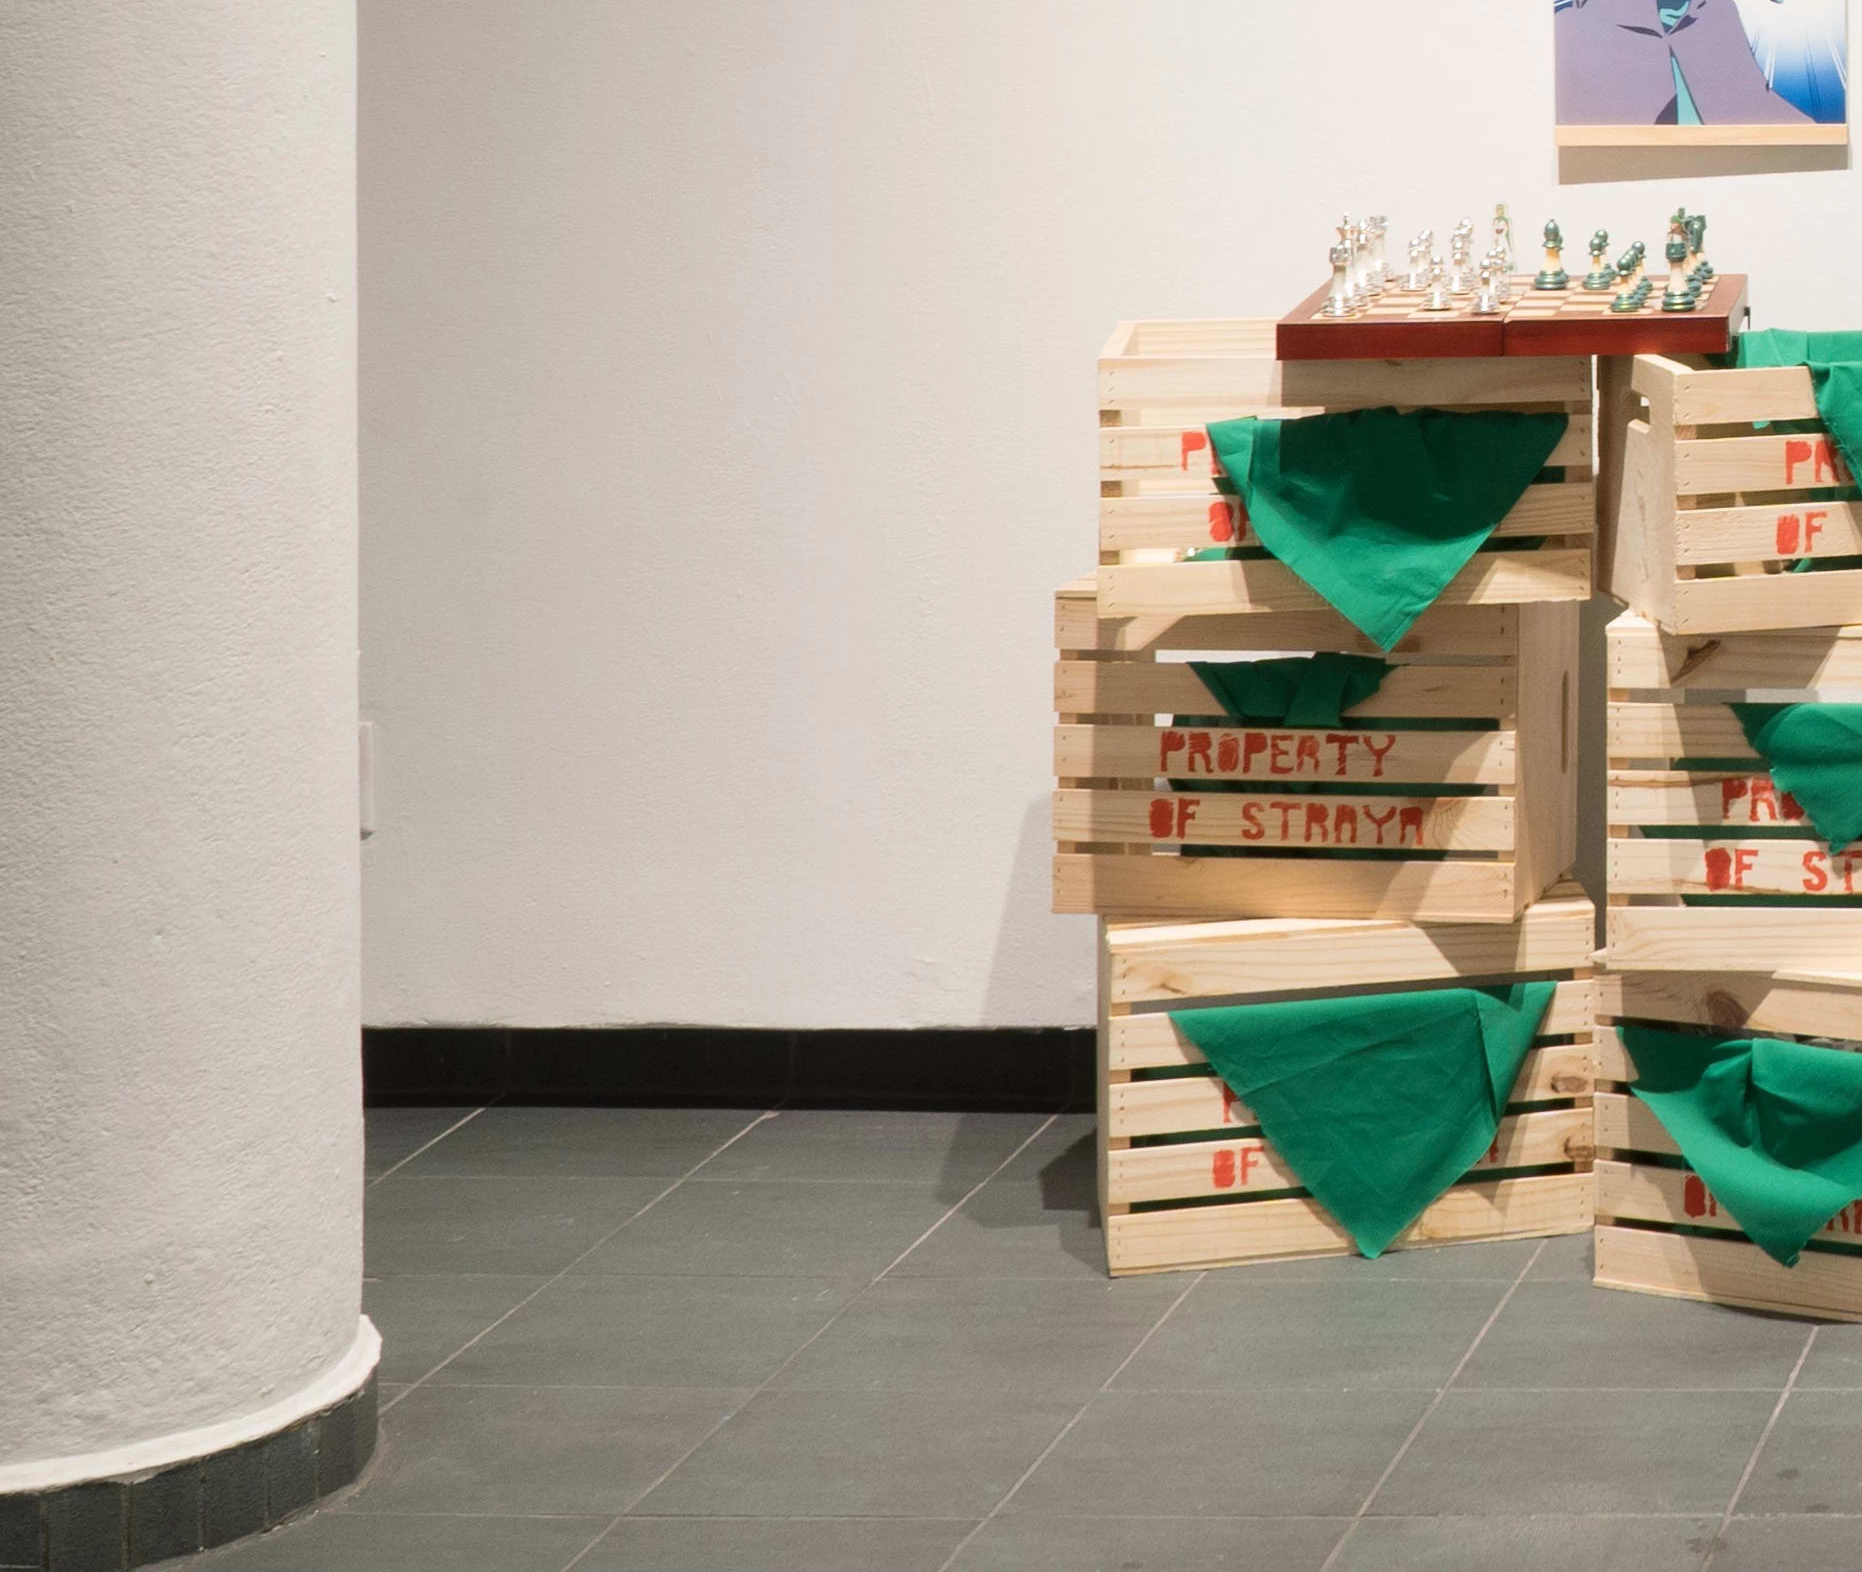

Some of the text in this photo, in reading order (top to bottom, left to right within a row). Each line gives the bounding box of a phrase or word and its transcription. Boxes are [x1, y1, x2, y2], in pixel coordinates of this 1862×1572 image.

[1776, 511, 1828, 555] OF
[1160, 731, 1397, 777] PROPERTY
[1149, 797, 1201, 840] OF
[1704, 847, 1759, 892] OF
[1213, 1147, 1265, 1189] OF
